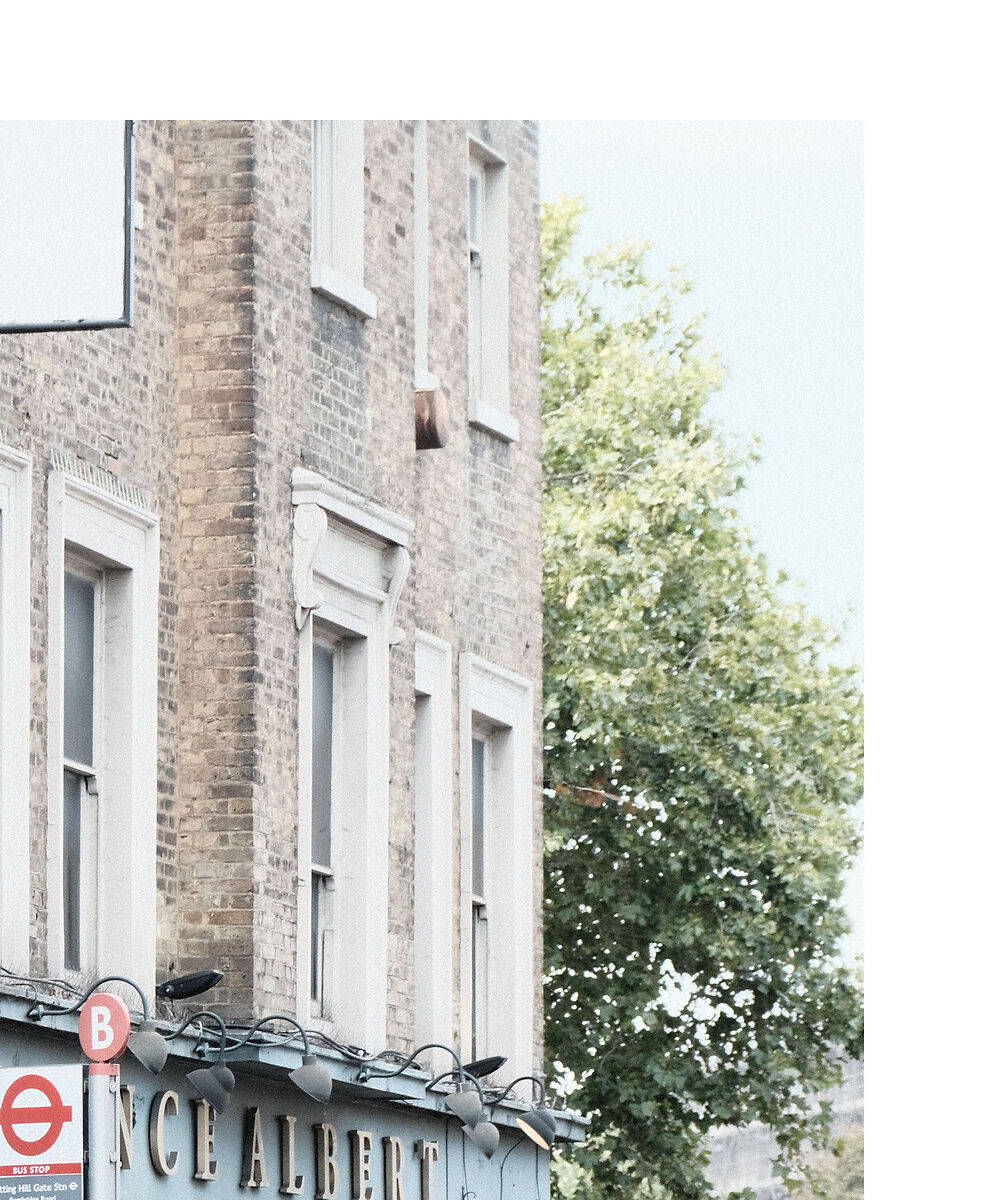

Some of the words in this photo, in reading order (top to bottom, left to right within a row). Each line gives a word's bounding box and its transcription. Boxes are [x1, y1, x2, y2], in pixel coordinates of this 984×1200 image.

[91, 1006, 114, 1050] B
[12, 1166, 28, 1175] BUS
[29, 1165, 51, 1174] STOP
[18, 1183, 32, 1193] Hill
[33, 1183, 52, 1192] Gate
[54, 1182, 68, 1191] Stn
